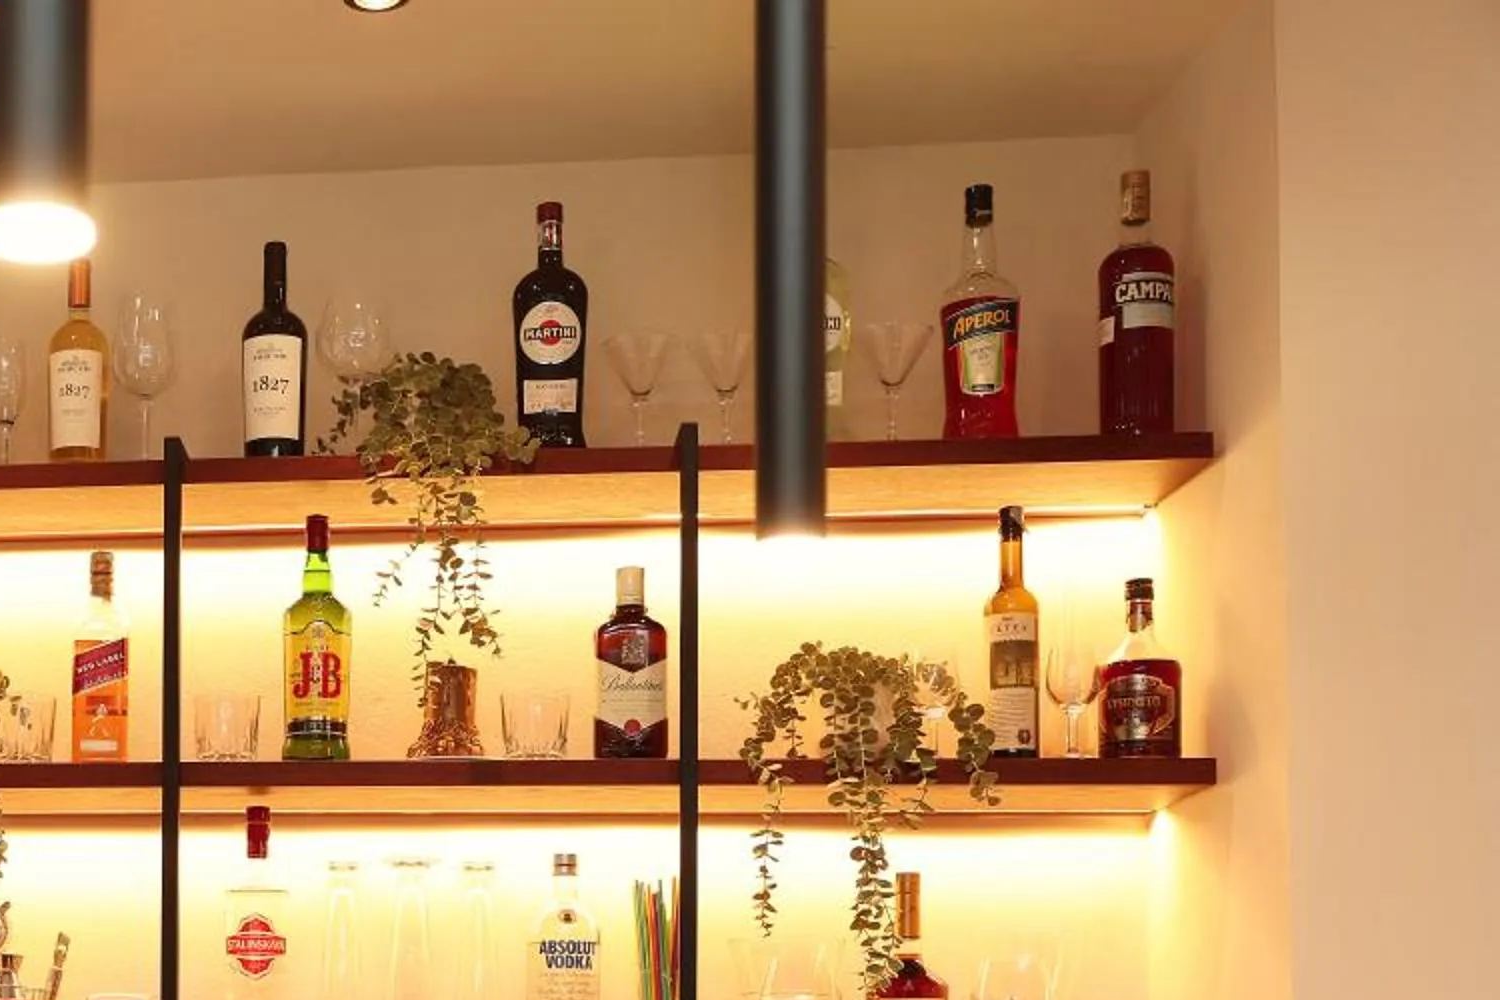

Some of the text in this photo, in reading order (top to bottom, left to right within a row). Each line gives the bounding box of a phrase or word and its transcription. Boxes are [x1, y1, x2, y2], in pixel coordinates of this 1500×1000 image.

[953, 309, 1011, 339] APEROL
[525, 327, 577, 340] MARTINI
[253, 375, 289, 394] 1827
[95, 652, 124, 668] LABEL
[539, 940, 596, 955] ABSOLUT
[546, 955, 593, 970] VODKA
